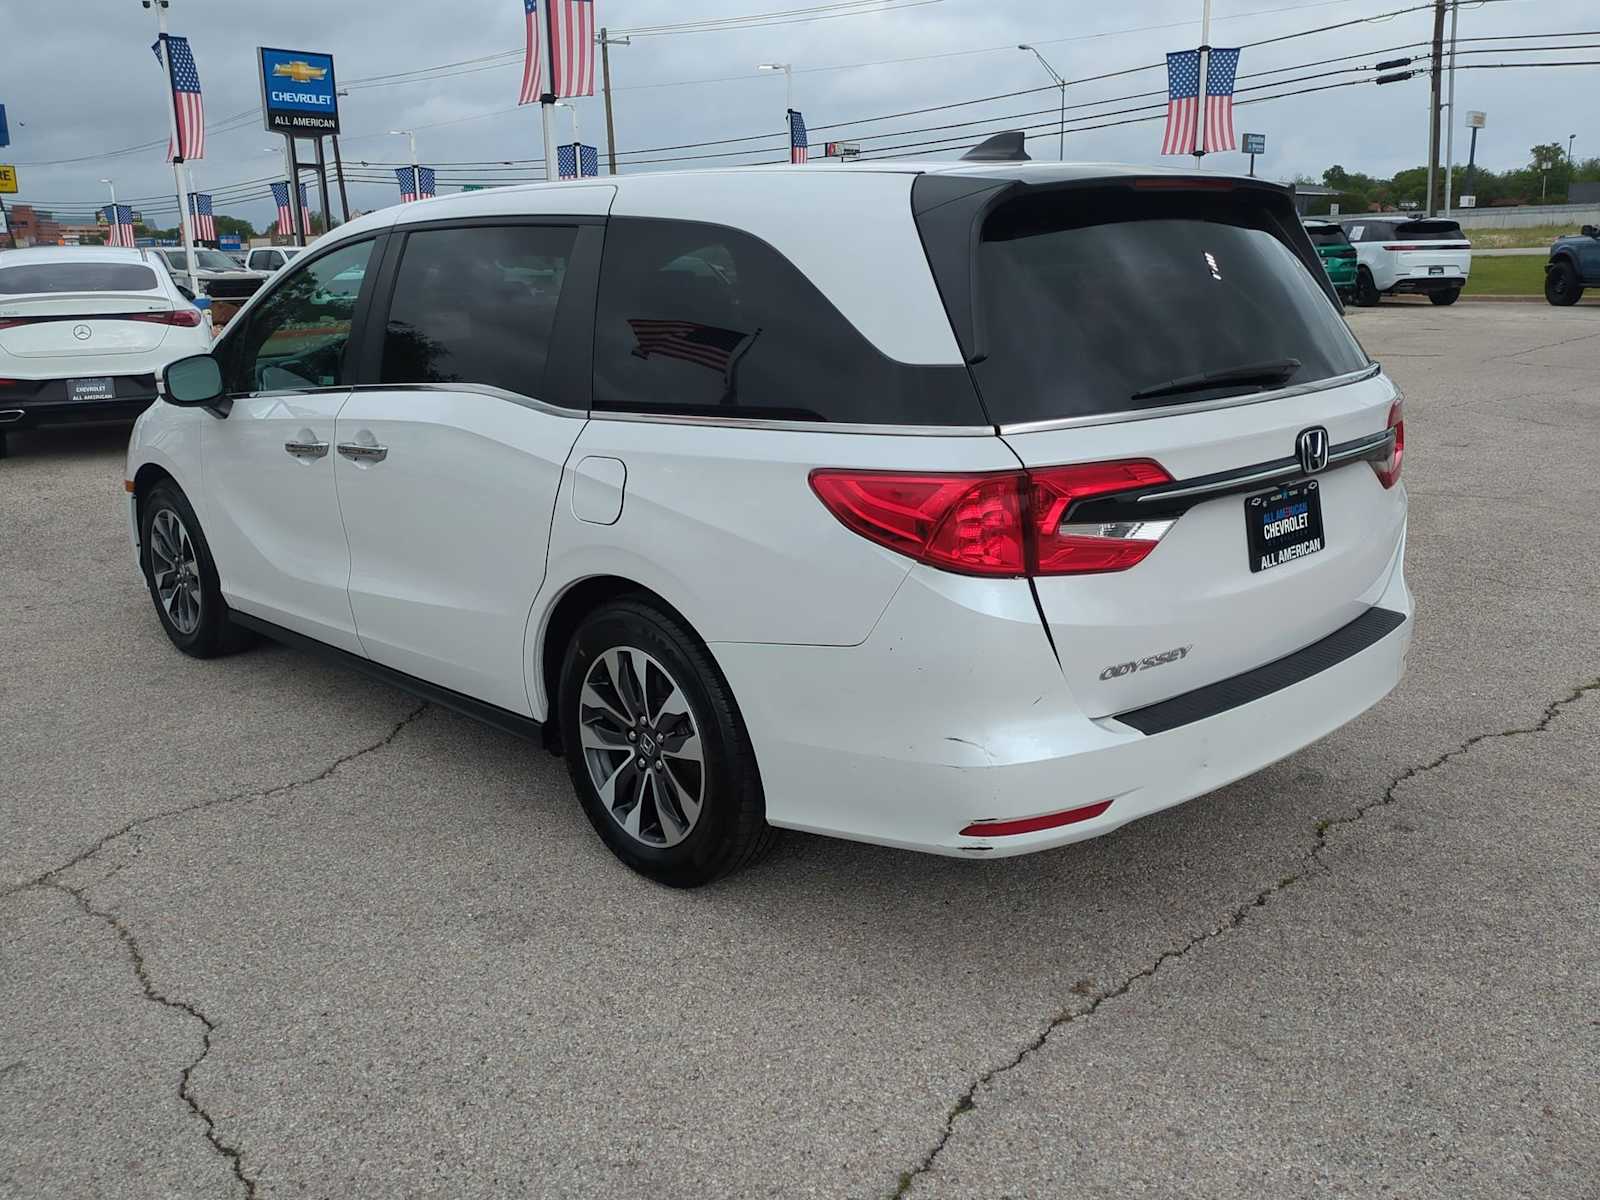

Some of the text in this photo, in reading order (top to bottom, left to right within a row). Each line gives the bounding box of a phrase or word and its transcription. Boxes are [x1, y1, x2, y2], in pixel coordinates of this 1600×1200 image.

[271, 91, 332, 105] CHEVROLET
[274, 115, 336, 128] ALL AMERICAN
[1264, 512, 1308, 540] CHEVROLET
[1261, 552, 1278, 570] ALL
[1278, 537, 1321, 564] AMERICAN
[1099, 644, 1192, 681] ODYSSEY
